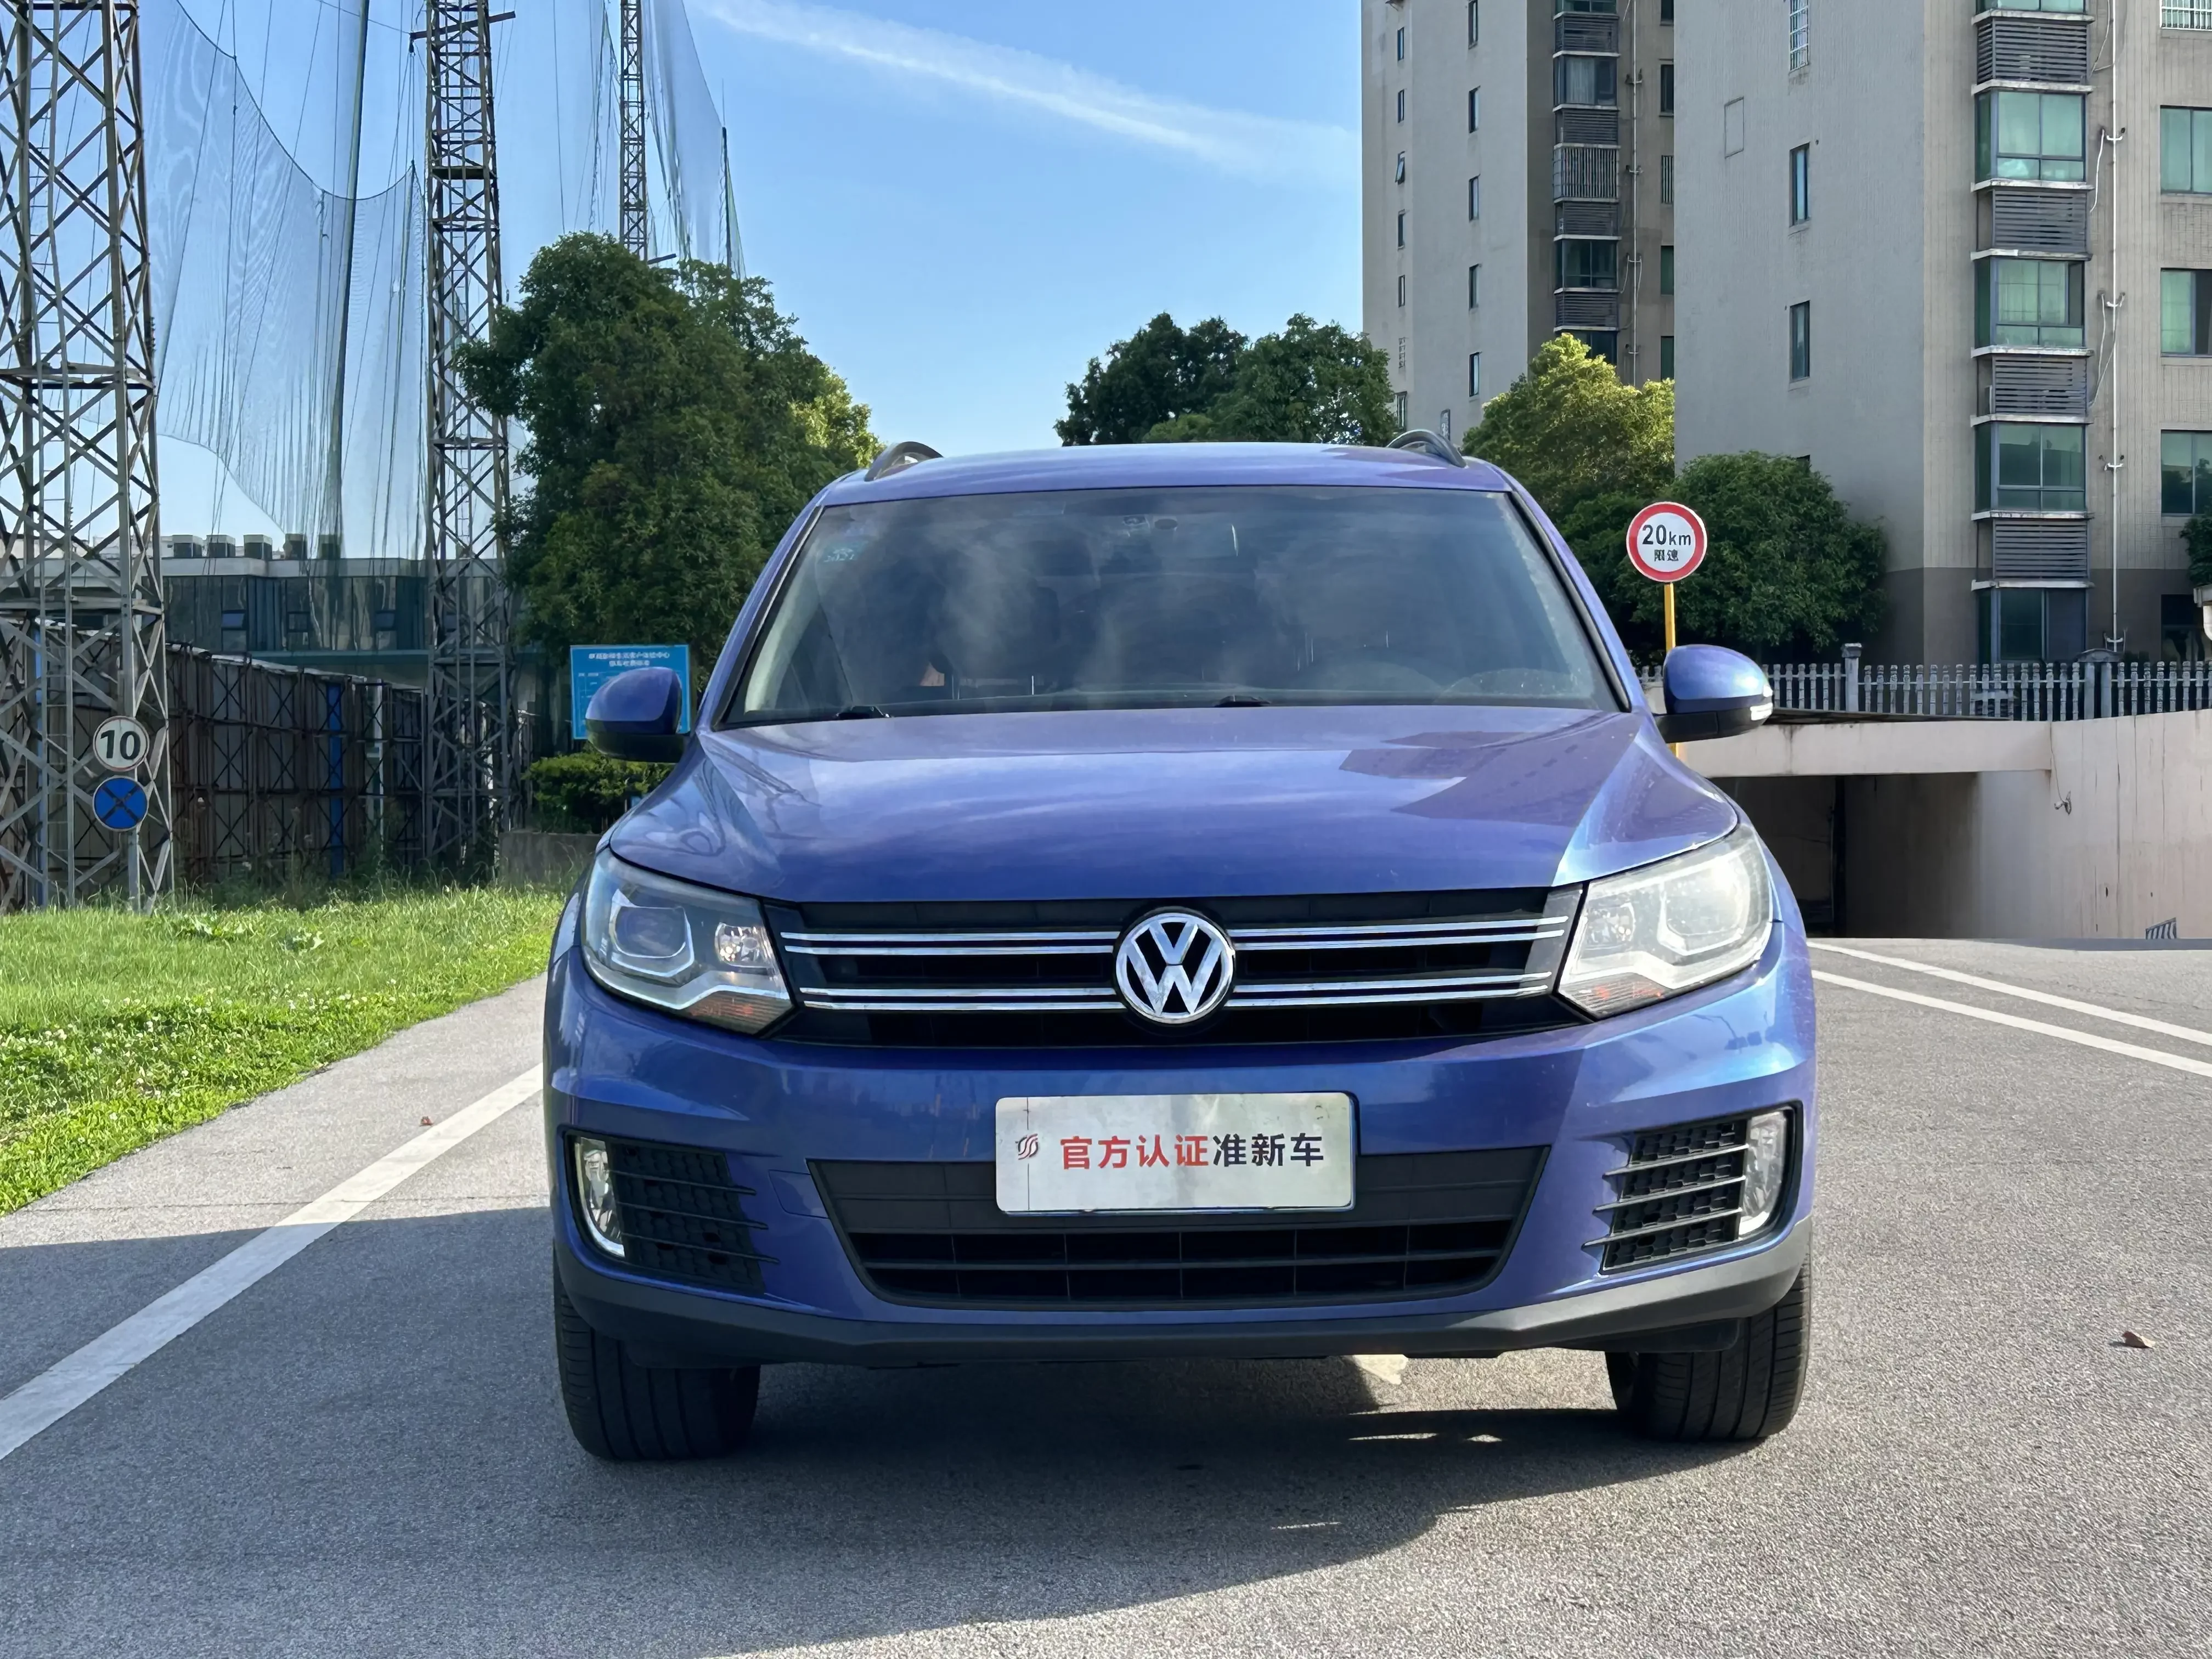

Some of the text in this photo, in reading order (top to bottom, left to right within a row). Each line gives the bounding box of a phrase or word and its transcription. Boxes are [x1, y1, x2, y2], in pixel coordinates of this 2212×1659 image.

[1642, 524, 1691, 546] 20km
[100, 729, 141, 760] 10
[1060, 1132, 1324, 1170] 官方认证准新车
